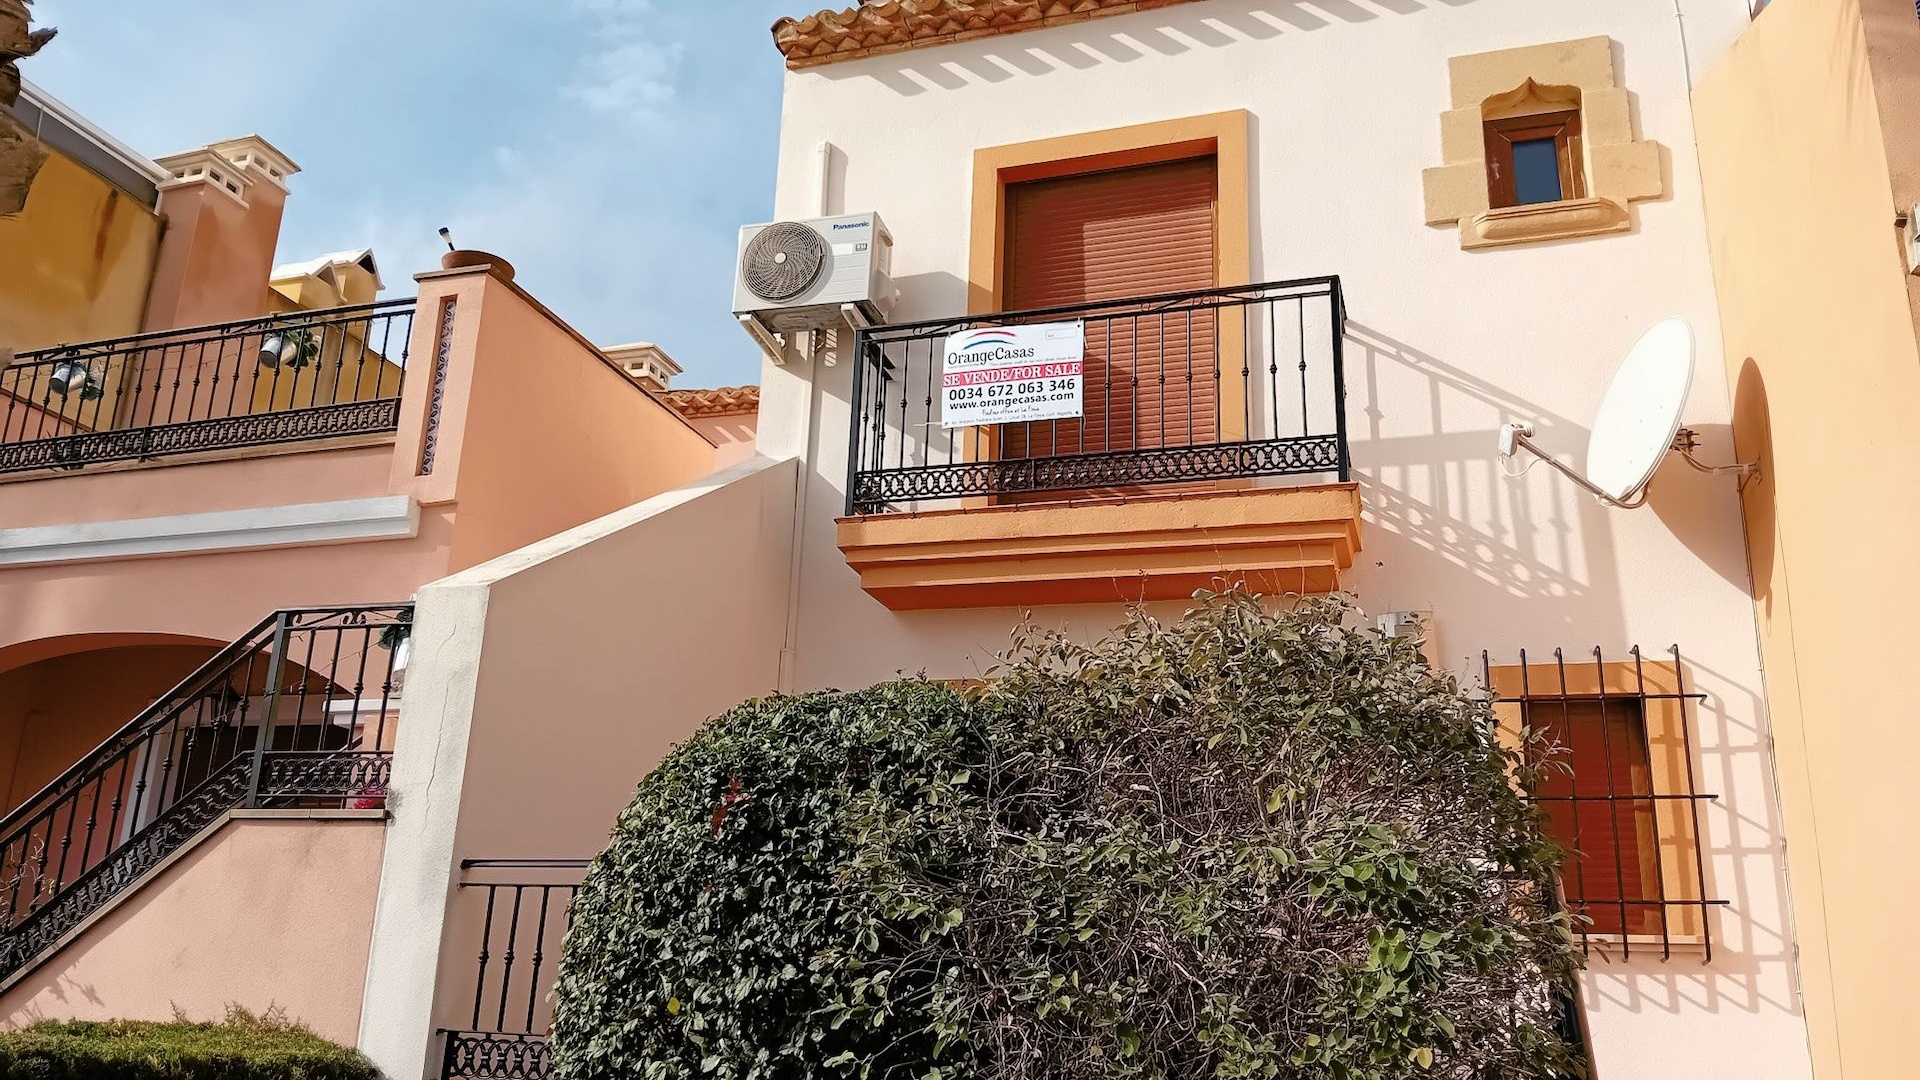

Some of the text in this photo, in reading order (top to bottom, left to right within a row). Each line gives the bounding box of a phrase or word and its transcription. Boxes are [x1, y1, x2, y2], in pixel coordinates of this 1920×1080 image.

[833, 221, 870, 230] Panasonic
[948, 347, 1035, 366] OrangeCasas
[943, 363, 1081, 386] SE VENDE/FOR SALE
[949, 379, 1075, 400] 0034 672 063 346
[949, 392, 1074, 410] www.orangecasas.com
